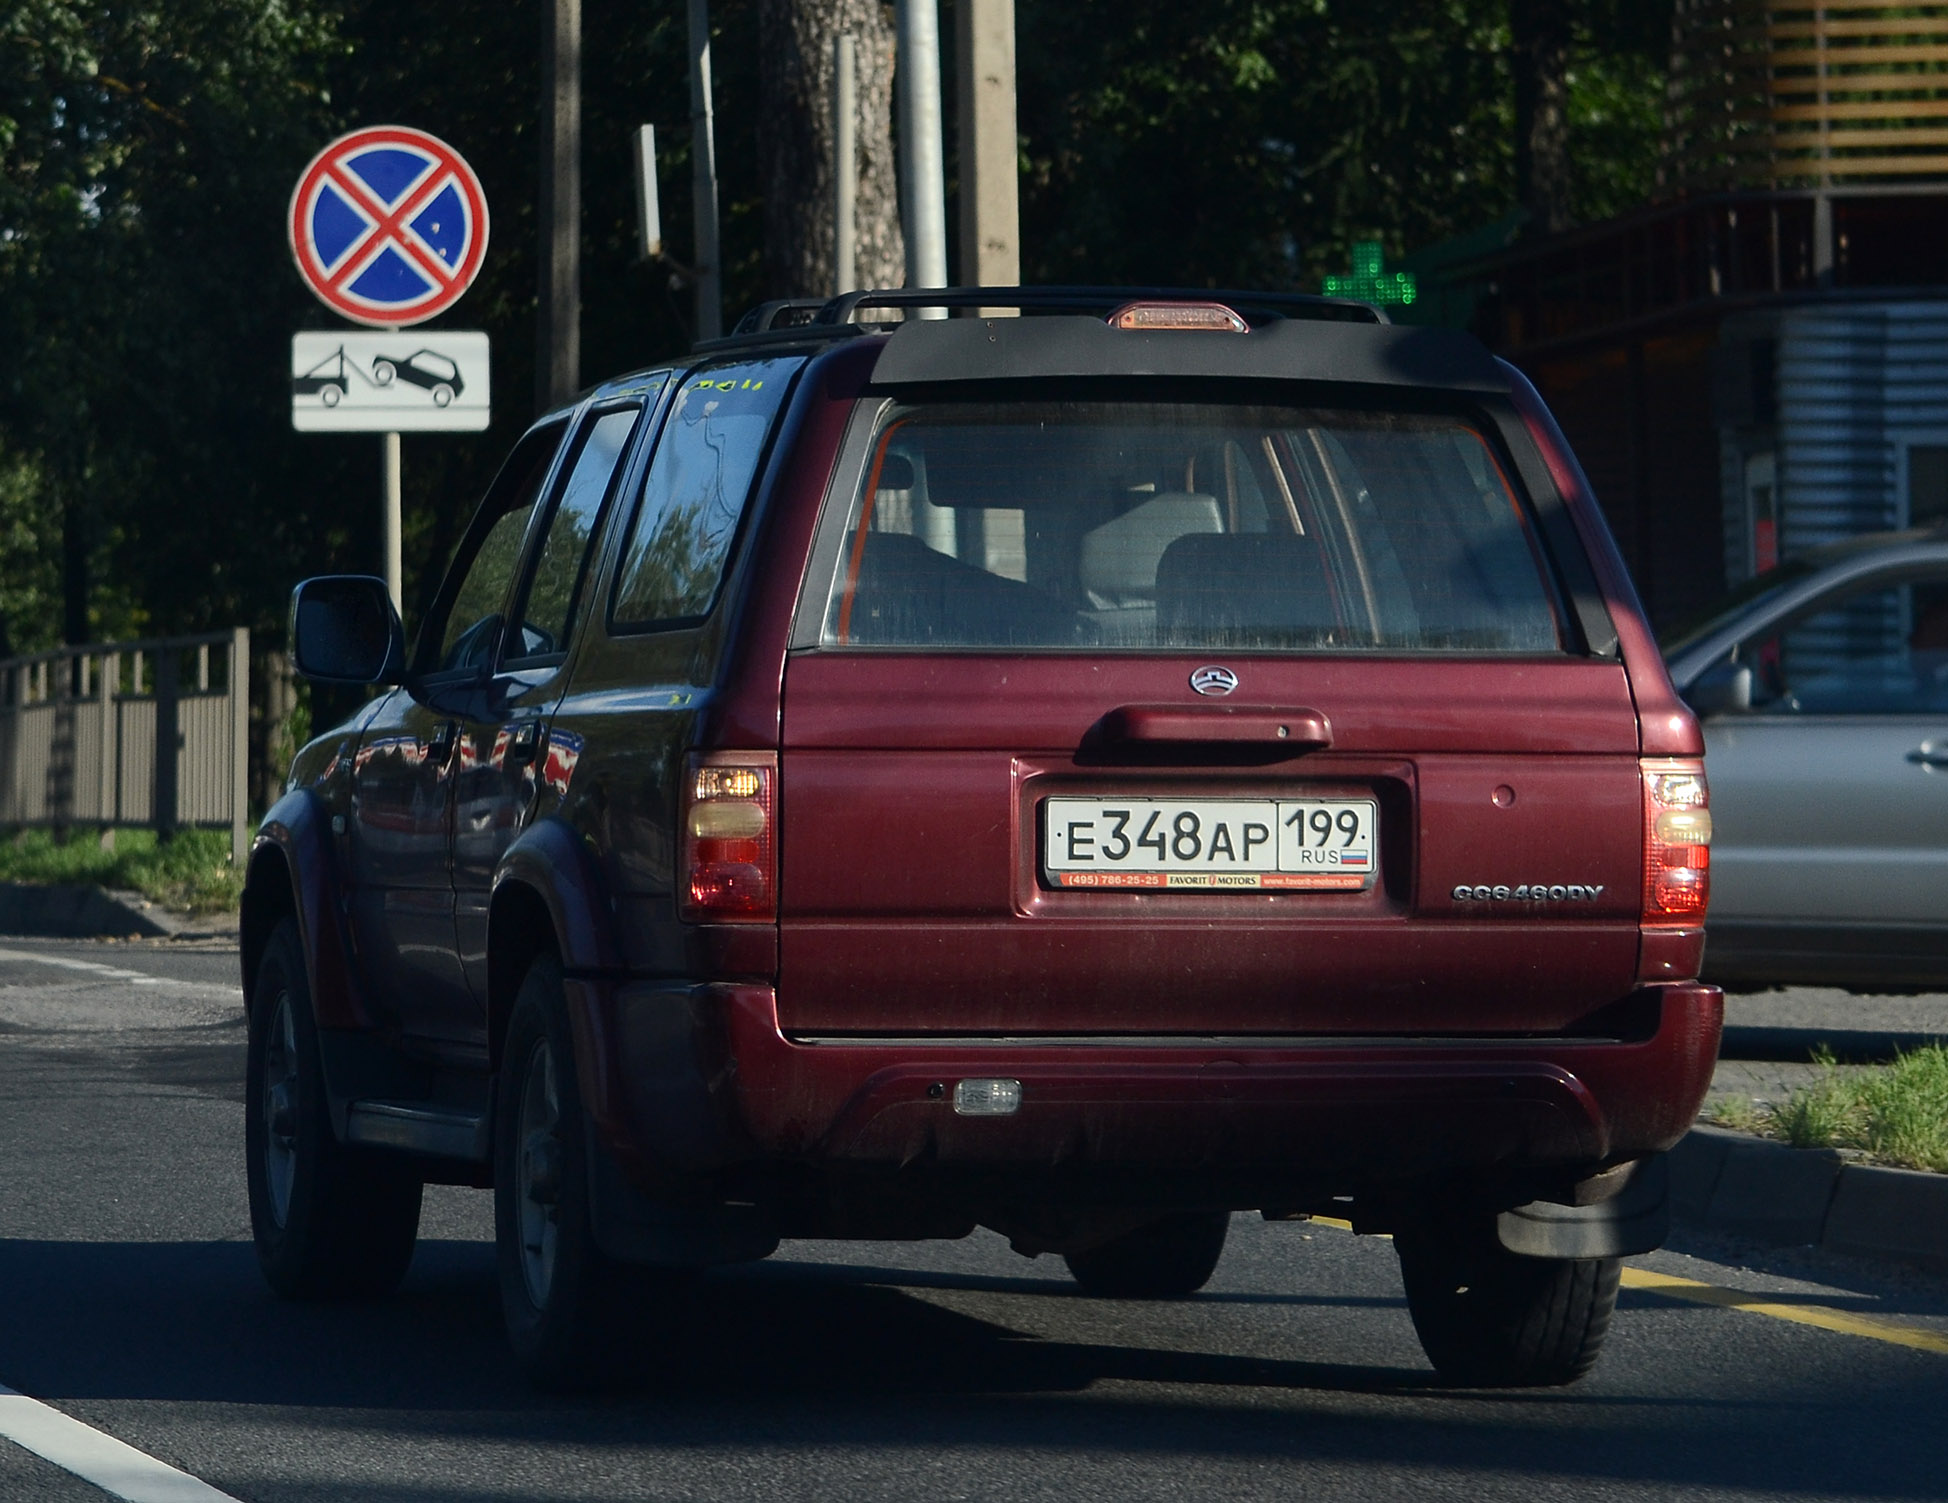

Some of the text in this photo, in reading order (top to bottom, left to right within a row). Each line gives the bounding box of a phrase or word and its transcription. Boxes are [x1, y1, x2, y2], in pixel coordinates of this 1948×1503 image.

[1285, 808, 1359, 848] 199
[1068, 810, 1269, 861] E348AP
[1301, 850, 1339, 863] RUS
[1068, 875, 1159, 885] (495) 786-25-25
[1169, 876, 1256, 885] FAVORIT MOTORS
[1263, 877, 1361, 886] www.favorit-motors.com
